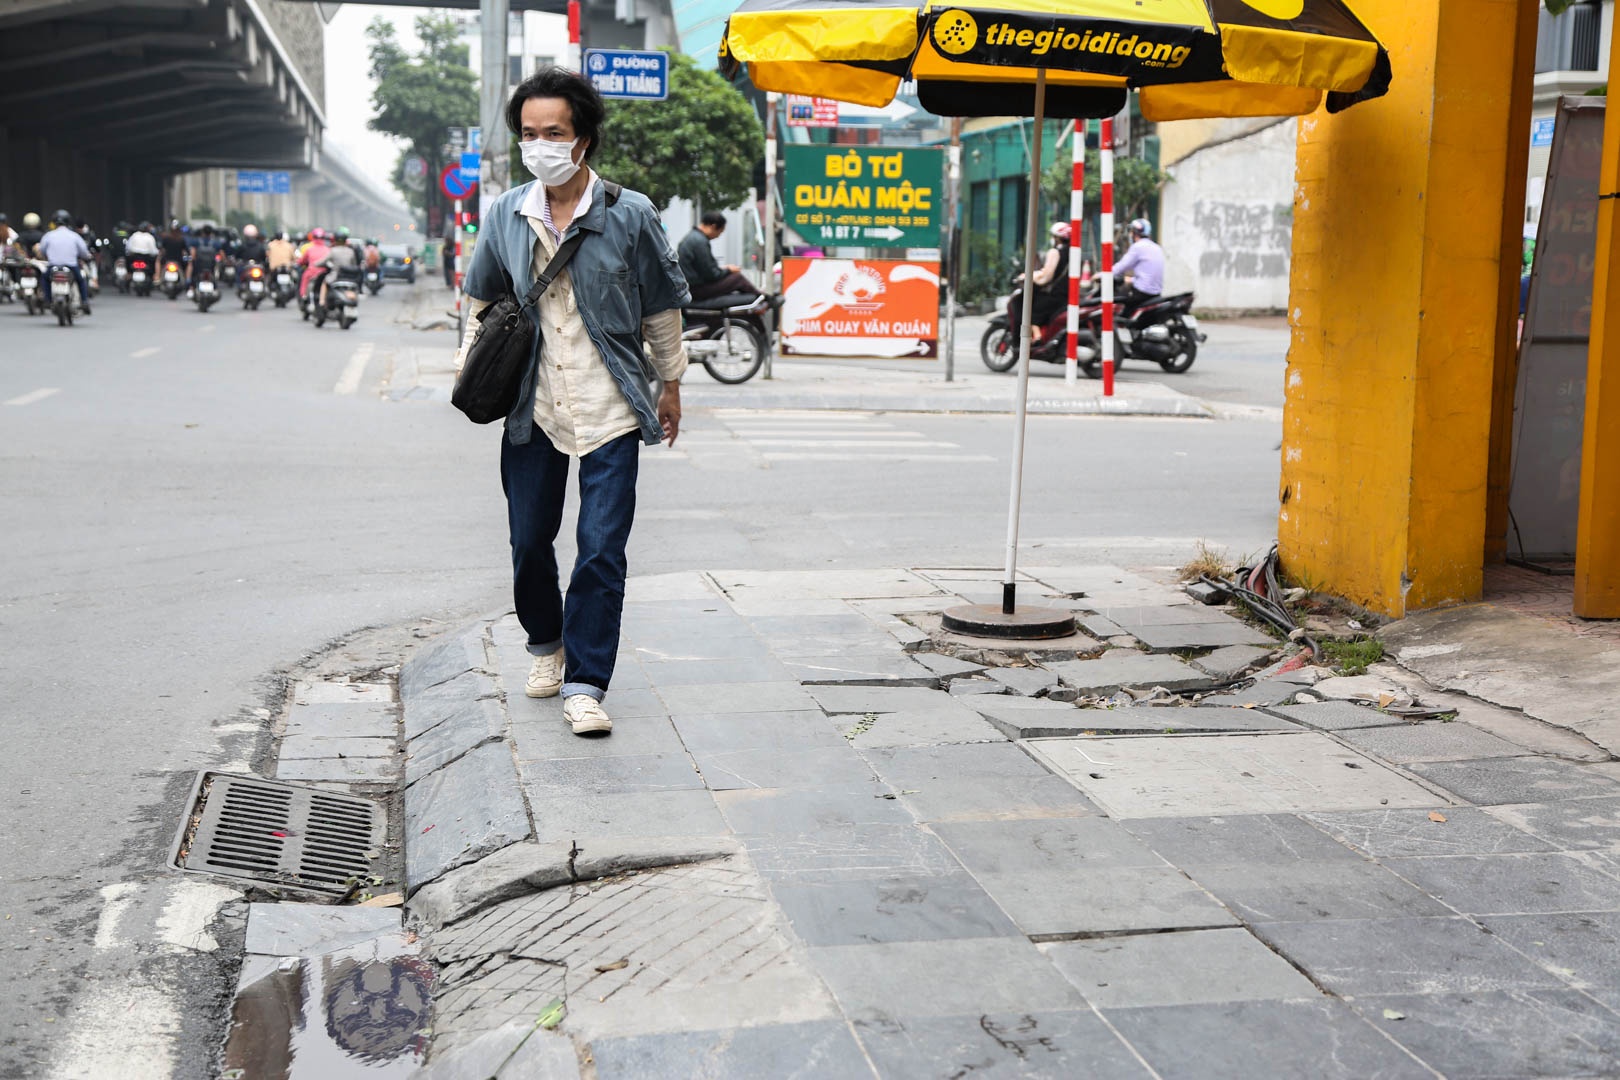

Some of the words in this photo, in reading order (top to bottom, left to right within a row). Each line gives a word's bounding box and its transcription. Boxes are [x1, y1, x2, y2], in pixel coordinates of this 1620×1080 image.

[985, 23, 1191, 68] thegioididong
[612, 54, 660, 70] ĐƯỜNG
[1140, 60, 1165, 68] .com
[592, 69, 625, 93] CHIẾN
[625, 70, 661, 94] THẮNG
[825, 149, 862, 178] BÒ
[867, 151, 903, 178] TƠ
[795, 180, 870, 208] QUÁN
[876, 180, 931, 214] MỘC
[820, 225, 834, 238] 14
[835, 226, 849, 239] BT
[852, 226, 861, 239] 7
[824, 320, 860, 334] QUAY
[863, 318, 890, 334] VĂN
[893, 319, 931, 335] QUÁN
